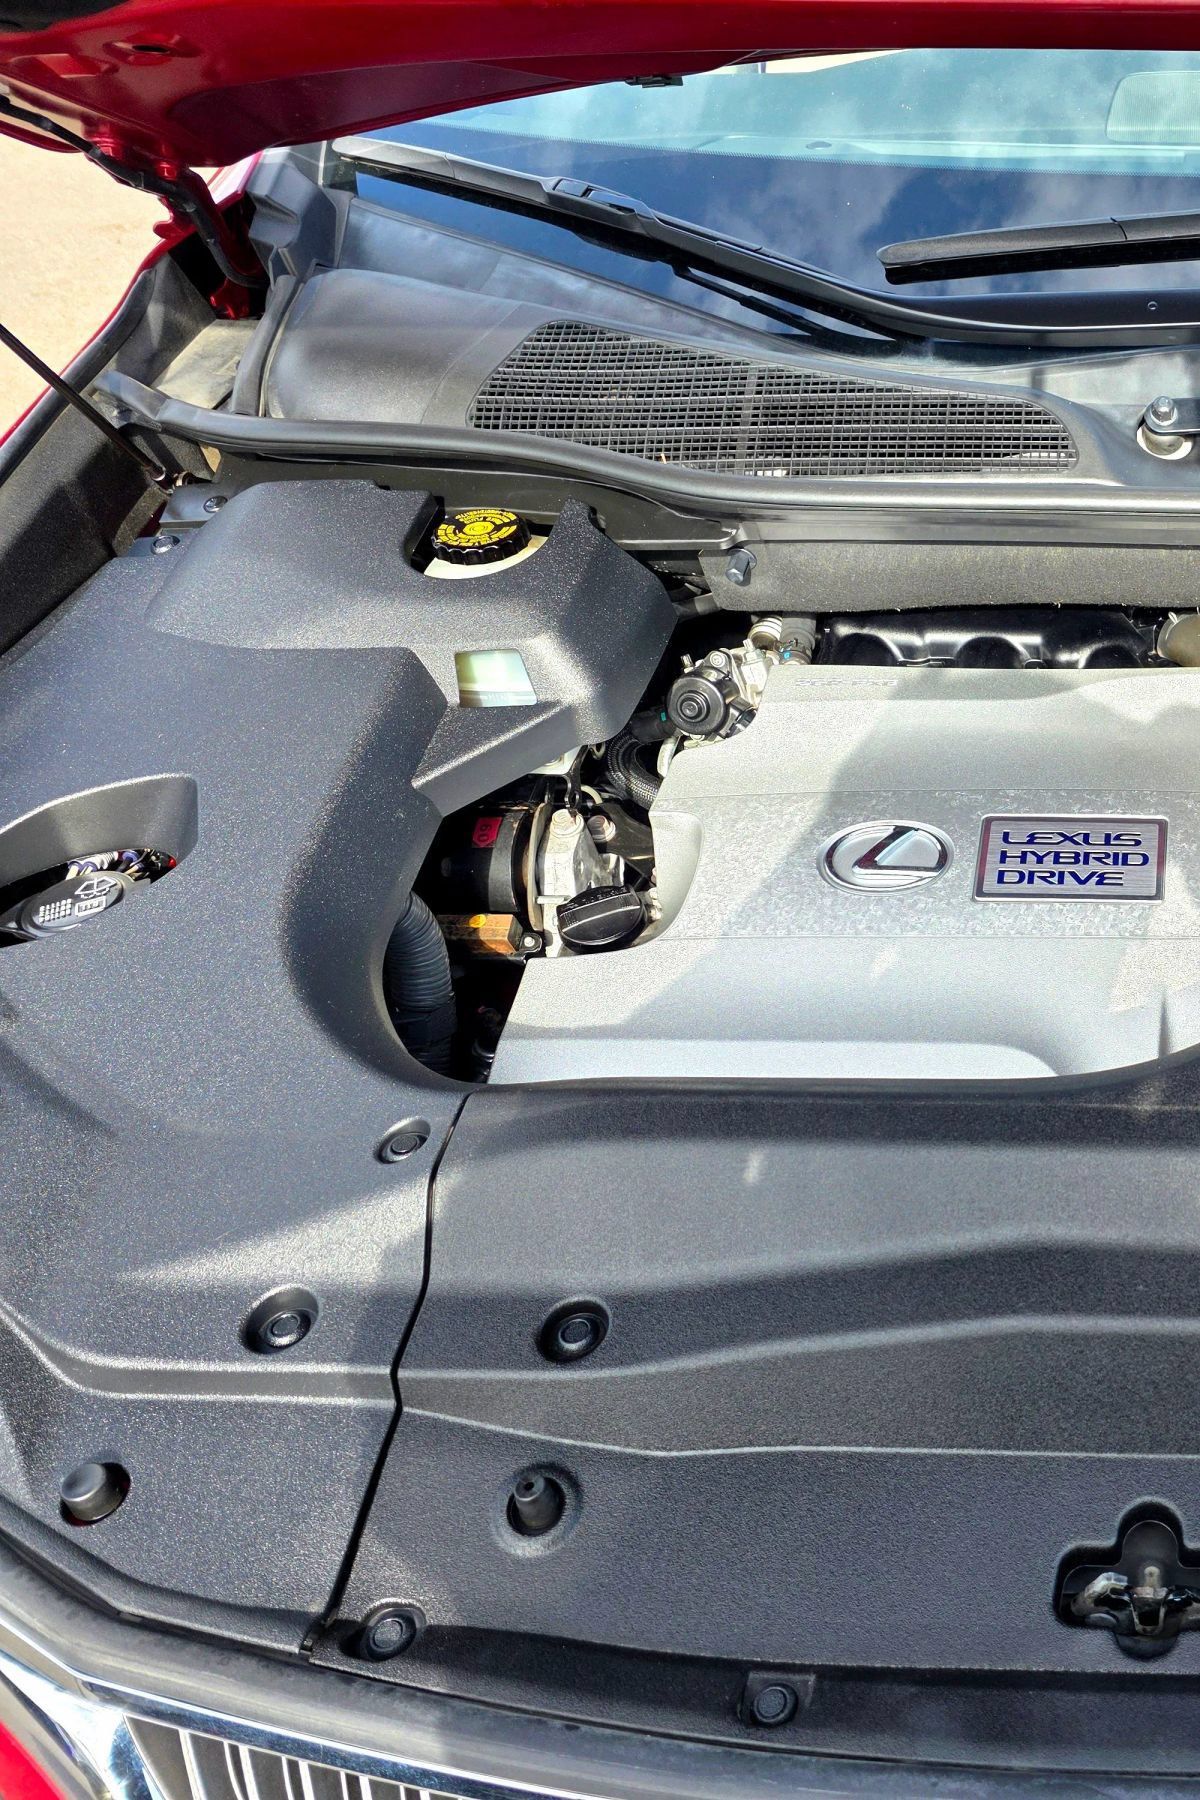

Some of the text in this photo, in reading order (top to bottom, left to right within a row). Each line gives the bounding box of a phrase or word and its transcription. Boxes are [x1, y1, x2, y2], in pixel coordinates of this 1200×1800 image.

[1002, 830, 1143, 847] LEXUS
[998, 849, 1150, 867] HYBRID
[996, 869, 1125, 886] DRIVE
